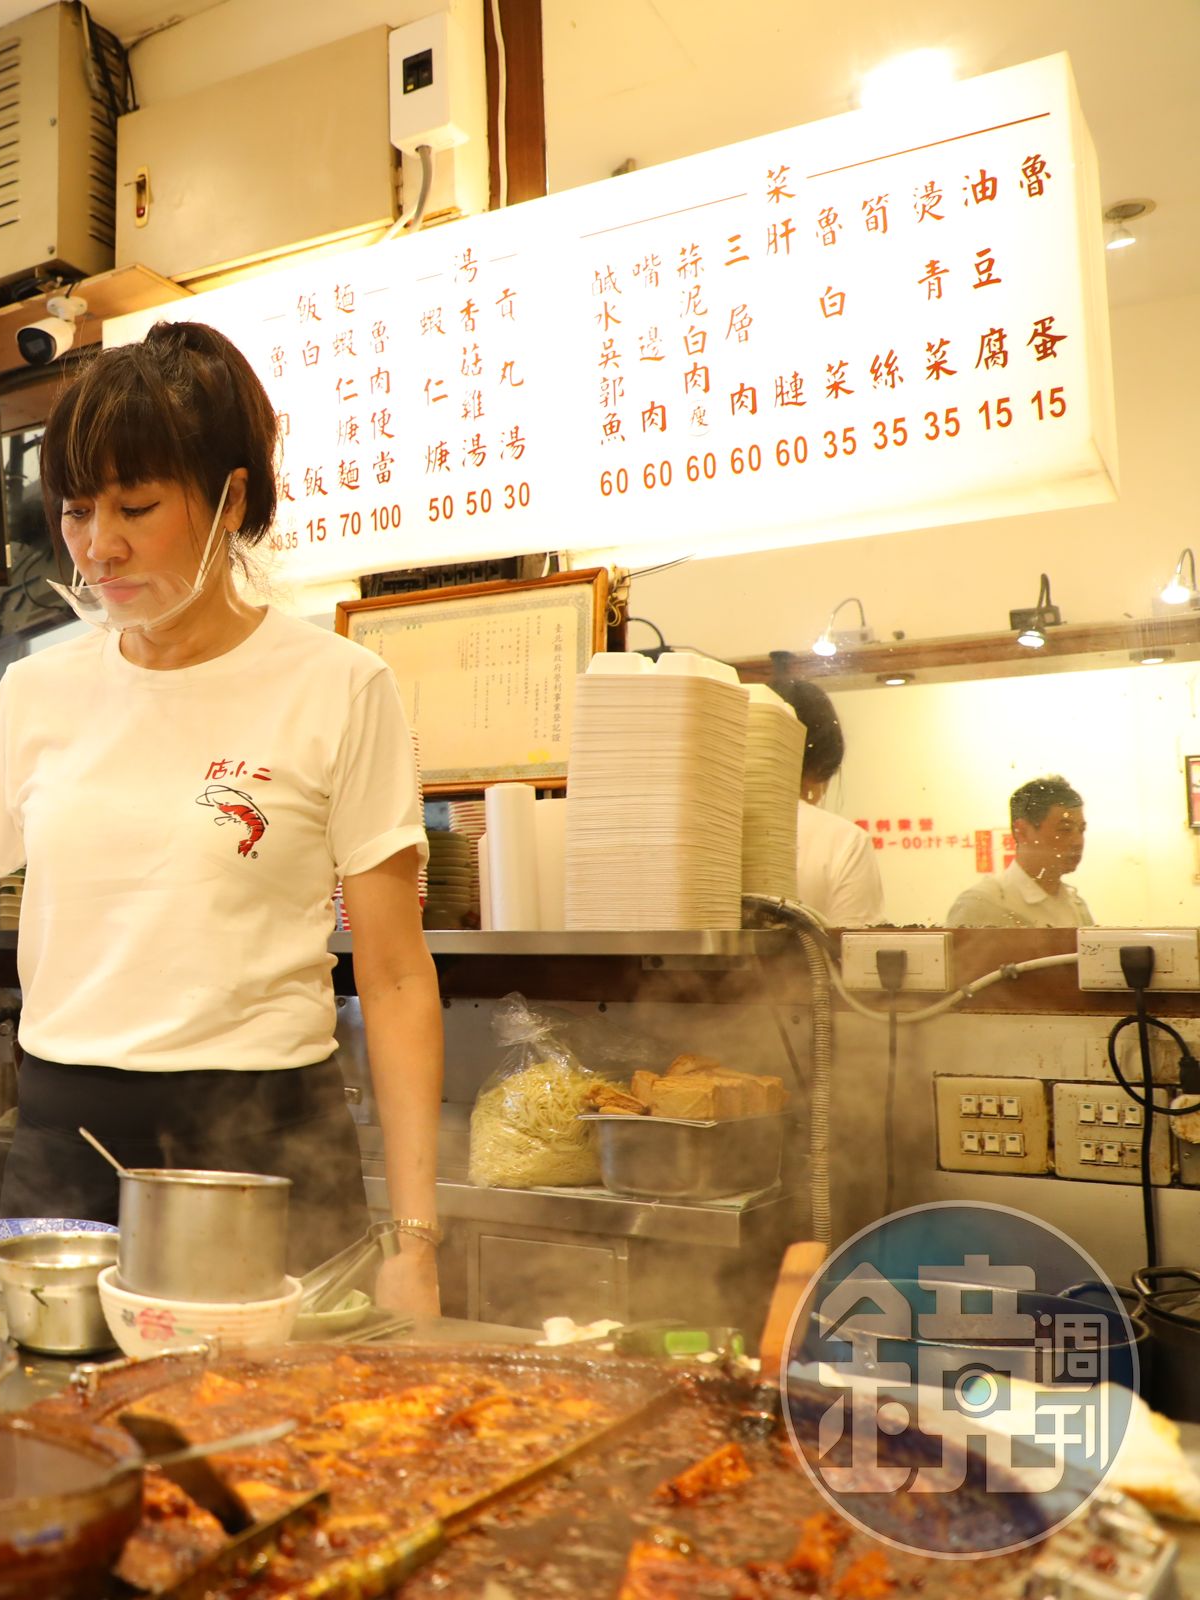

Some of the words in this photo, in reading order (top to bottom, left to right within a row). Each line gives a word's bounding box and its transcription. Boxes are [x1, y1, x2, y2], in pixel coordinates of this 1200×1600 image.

[766, 164, 797, 204] 菜
[454, 247, 478, 283] 湯
[962, 168, 1009, 370] 油豆腐
[1019, 154, 1068, 361] 魯蛋
[861, 193, 904, 389] 筍絲
[913, 180, 958, 380] 燙青菜
[816, 206, 855, 399] 魯白菜
[724, 234, 758, 416] 三層肉
[632, 253, 667, 432] 嘴邊肉
[495, 287, 526, 461] 貢丸湯
[302, 340, 328, 496] 白飯
[370, 320, 395, 485] 魯肉便當
[978, 396, 1013, 430] 15
[1031, 386, 1067, 421] 15
[873, 417, 908, 450] 35
[923, 407, 960, 441] 35
[730, 444, 761, 475] 60
[776, 435, 808, 467] 60
[823, 426, 857, 459] 35
[600, 467, 628, 496] 60
[643, 460, 672, 489] 60
[686, 452, 716, 482] 60
[428, 495, 454, 522] 50
[466, 488, 492, 516] 50
[503, 482, 530, 510] 30
[306, 517, 327, 543] 15
[340, 511, 361, 537] 70
[370, 504, 401, 531] 100
[204, 758, 273, 781] 店小二
